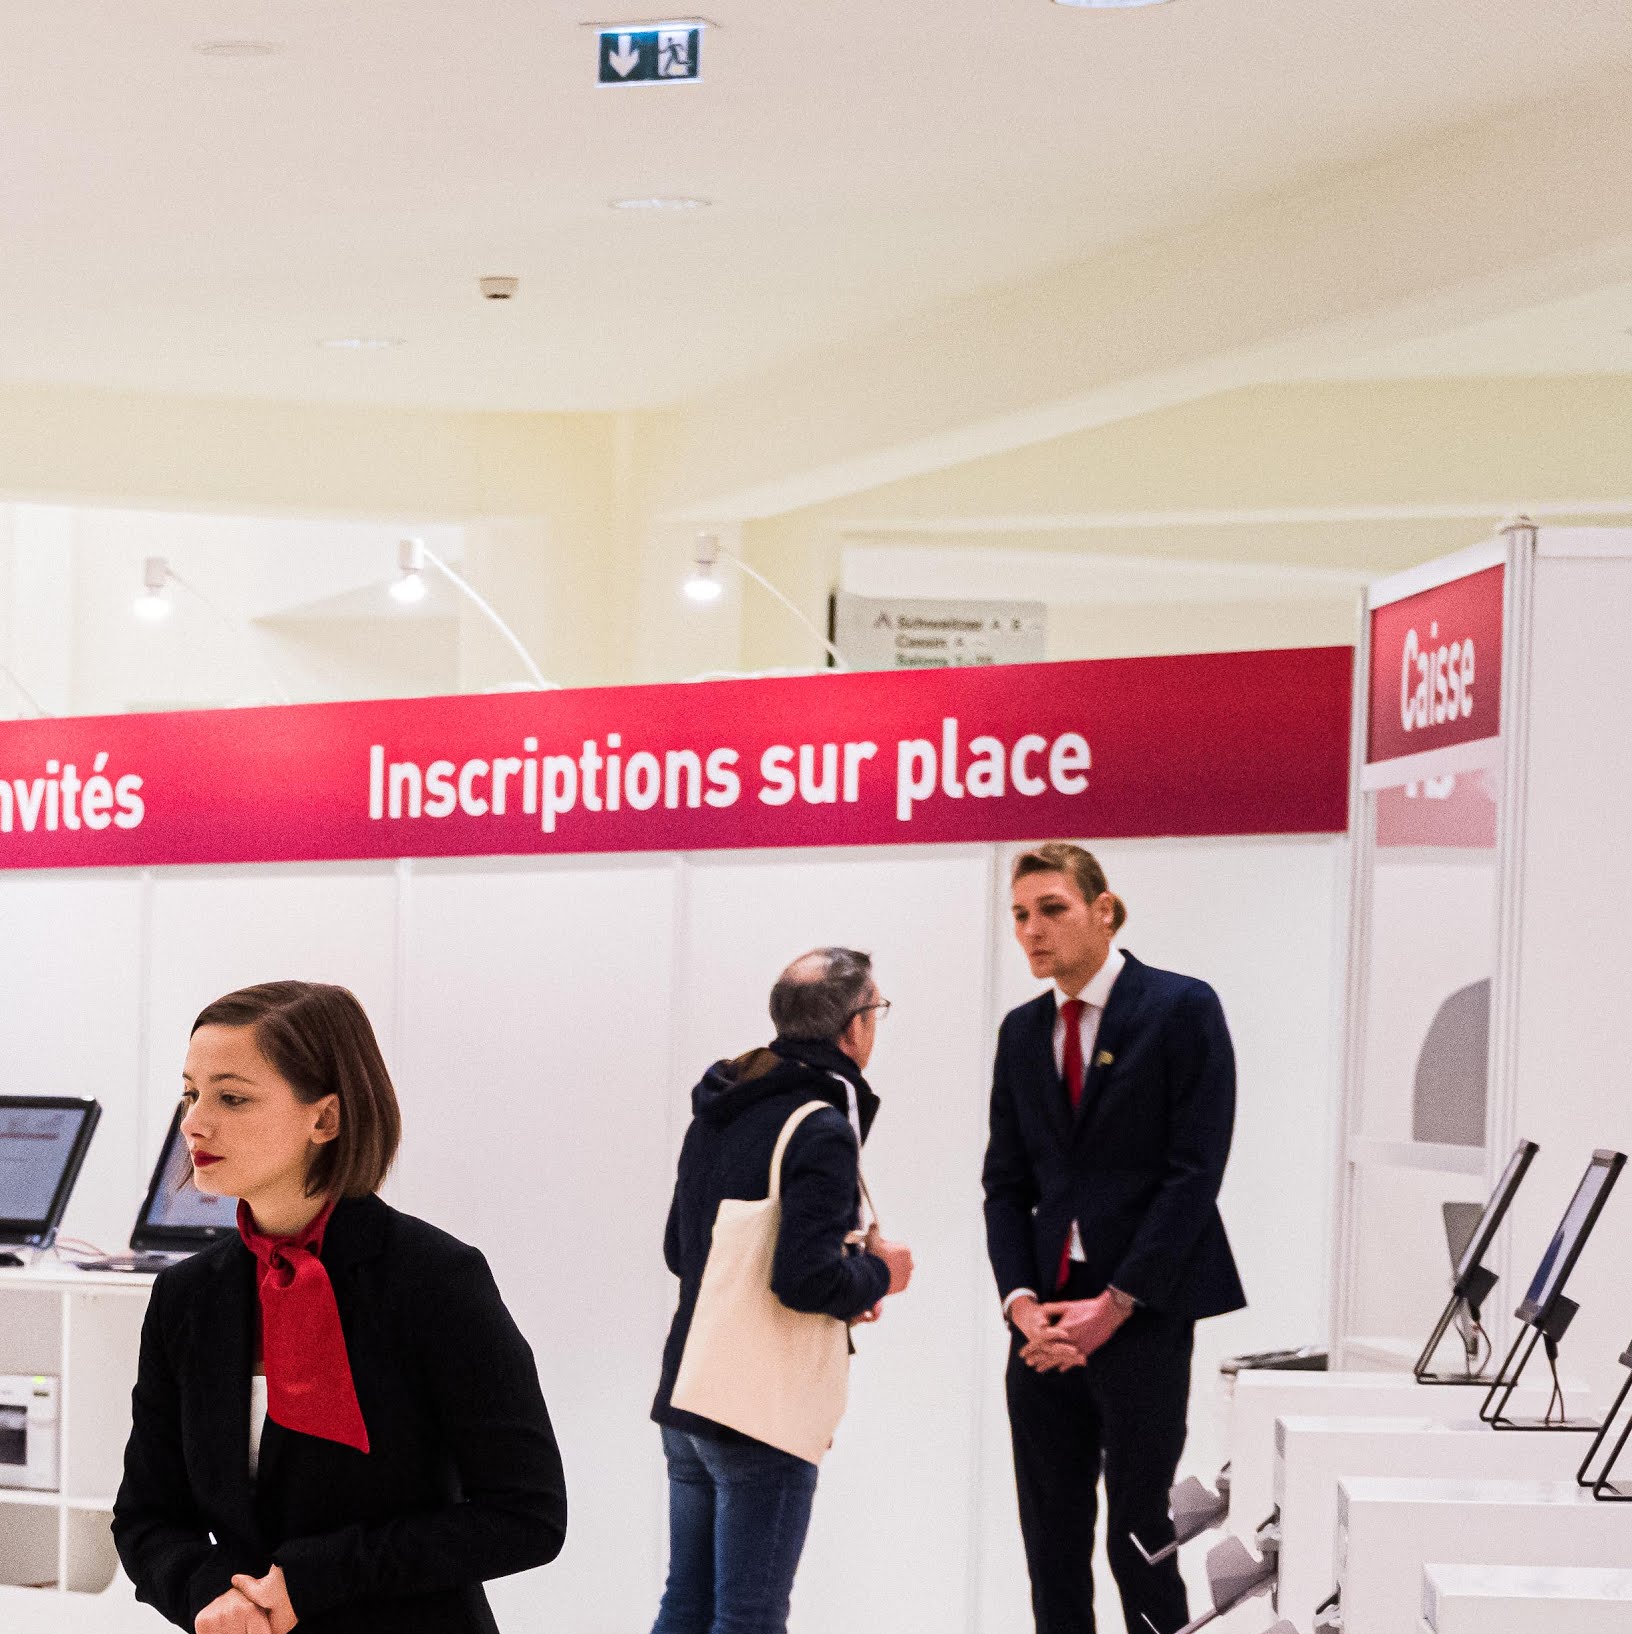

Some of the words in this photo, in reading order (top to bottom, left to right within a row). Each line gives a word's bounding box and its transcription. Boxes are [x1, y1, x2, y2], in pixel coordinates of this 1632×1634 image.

[1401, 620, 1474, 732] Caisse
[369, 733, 740, 833] Inscriptions
[758, 740, 878, 805] sur
[897, 718, 1092, 821] place
